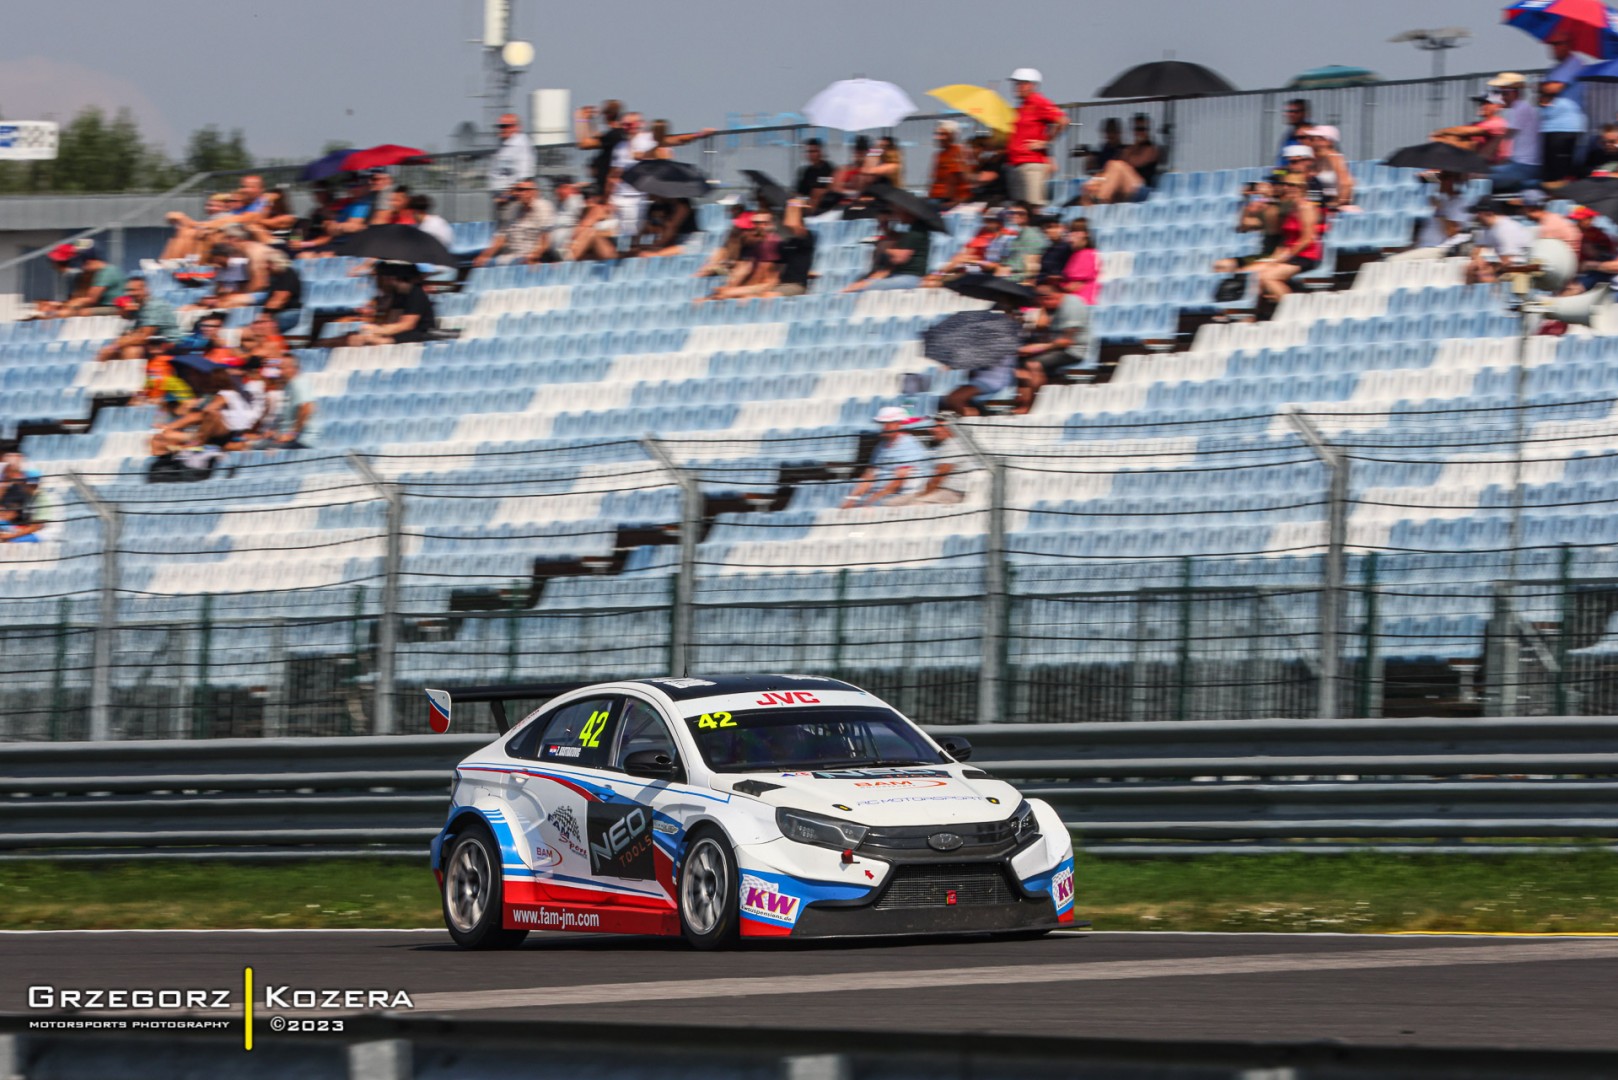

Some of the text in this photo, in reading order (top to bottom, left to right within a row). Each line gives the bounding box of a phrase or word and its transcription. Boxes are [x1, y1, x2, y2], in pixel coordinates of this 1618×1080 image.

[756, 692, 821, 706] JVC
[579, 711, 610, 748] 42
[698, 712, 738, 729] 42
[854, 780, 912, 788] BAM
[547, 813, 570, 840] FAM
[536, 847, 553, 858] BAM
[590, 807, 646, 873] NEO
[619, 834, 652, 868] TOOLS
[746, 886, 798, 916] KW
[512, 906, 600, 930] www.fam-jm.com
